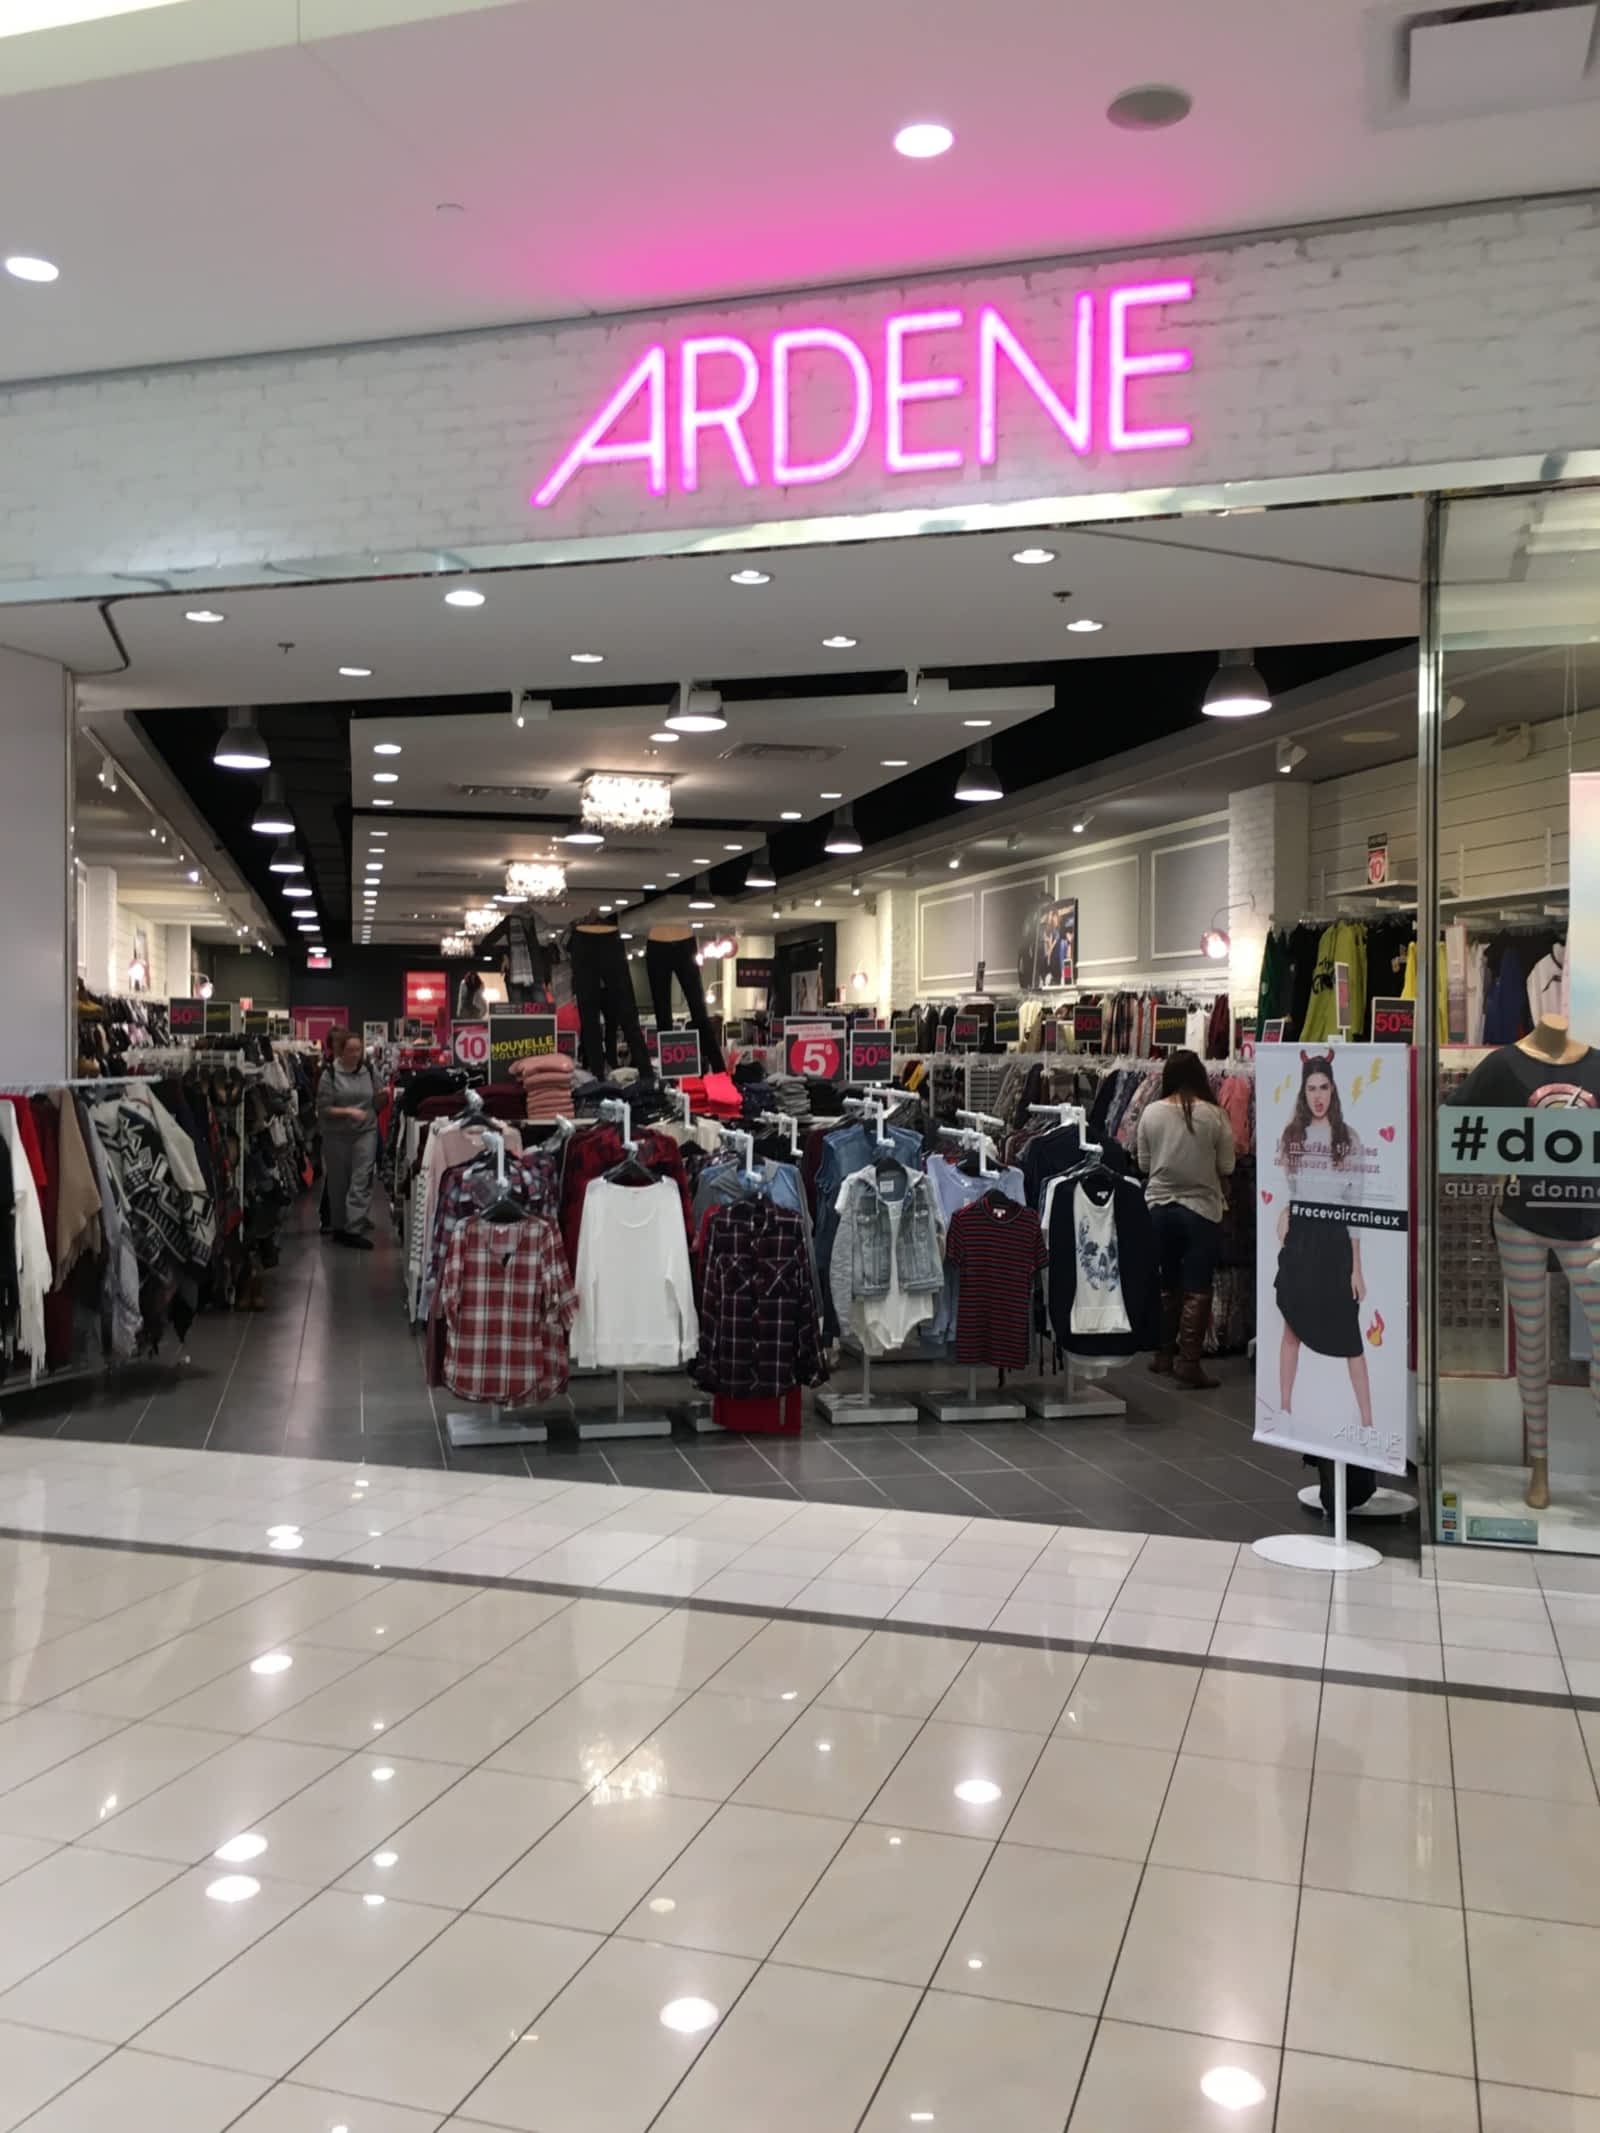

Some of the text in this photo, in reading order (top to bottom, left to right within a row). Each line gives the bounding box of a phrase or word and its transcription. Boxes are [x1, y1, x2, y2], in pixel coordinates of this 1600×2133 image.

[530, 279, 1193, 508] ARDENE
[1375, 1012, 1413, 1033] 50%
[458, 1035, 487, 1060] 10
[491, 1035, 553, 1053] NOUVELLE
[491, 1046, 556, 1061] COLLECTION
[661, 1043, 697, 1065] 50%
[853, 1045, 890, 1067] 50%
[1451, 1115, 1600, 1164] #do
[1444, 1179, 1600, 1198] quand donn
[1291, 1204, 1400, 1227] #recevoircmieux
